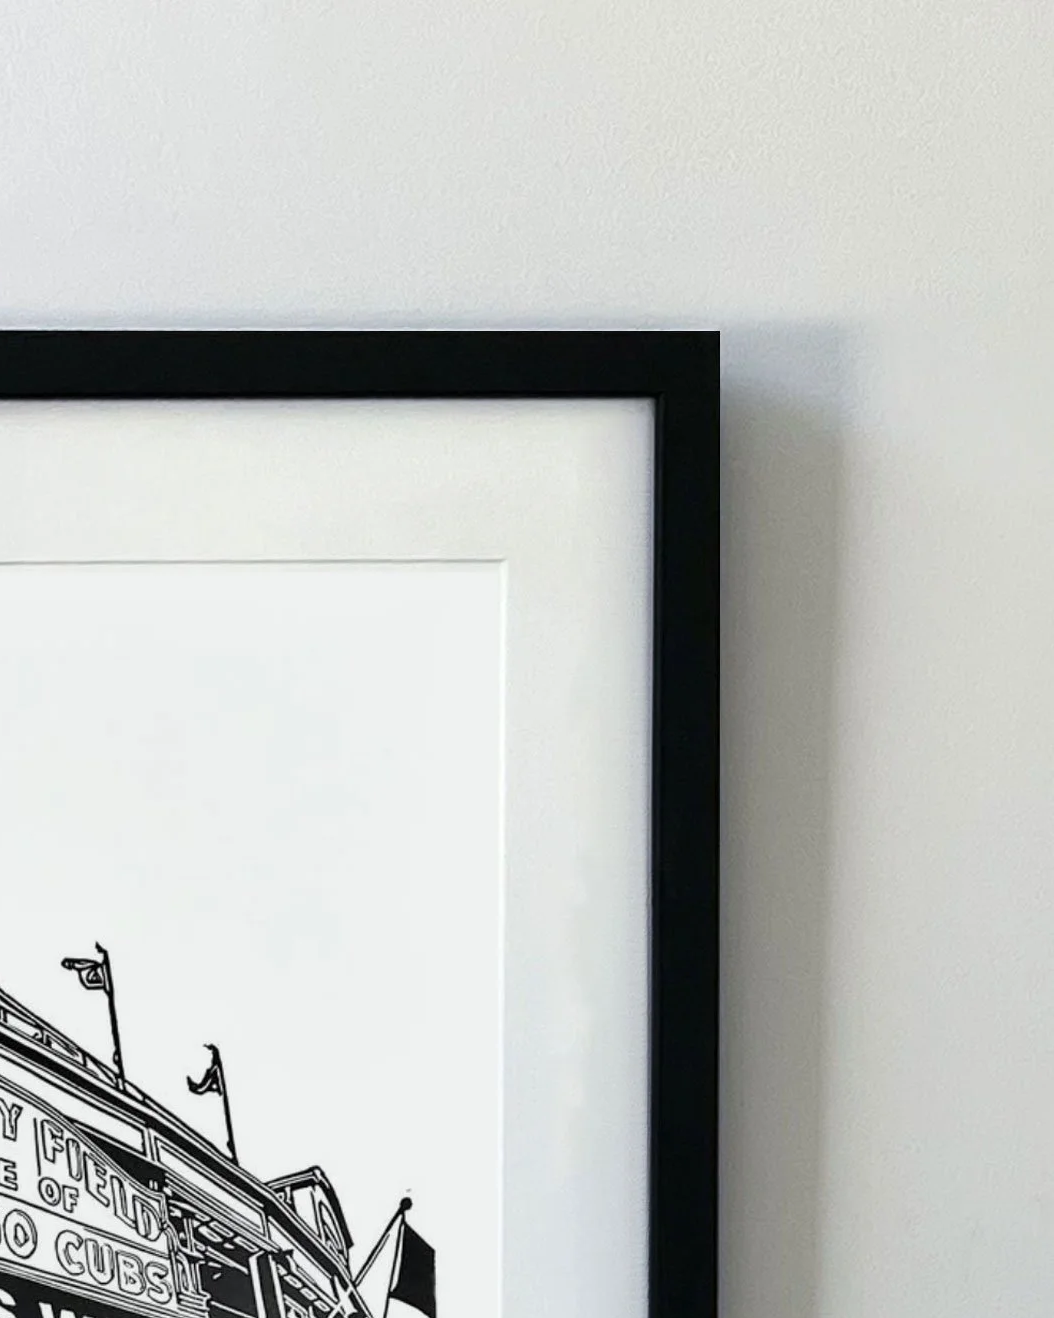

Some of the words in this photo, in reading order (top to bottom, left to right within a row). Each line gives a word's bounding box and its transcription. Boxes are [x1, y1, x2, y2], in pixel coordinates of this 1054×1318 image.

[37, 1176, 80, 1213] OF
[39, 1118, 167, 1241] FIELD
[54, 1229, 173, 1305] CUBS
